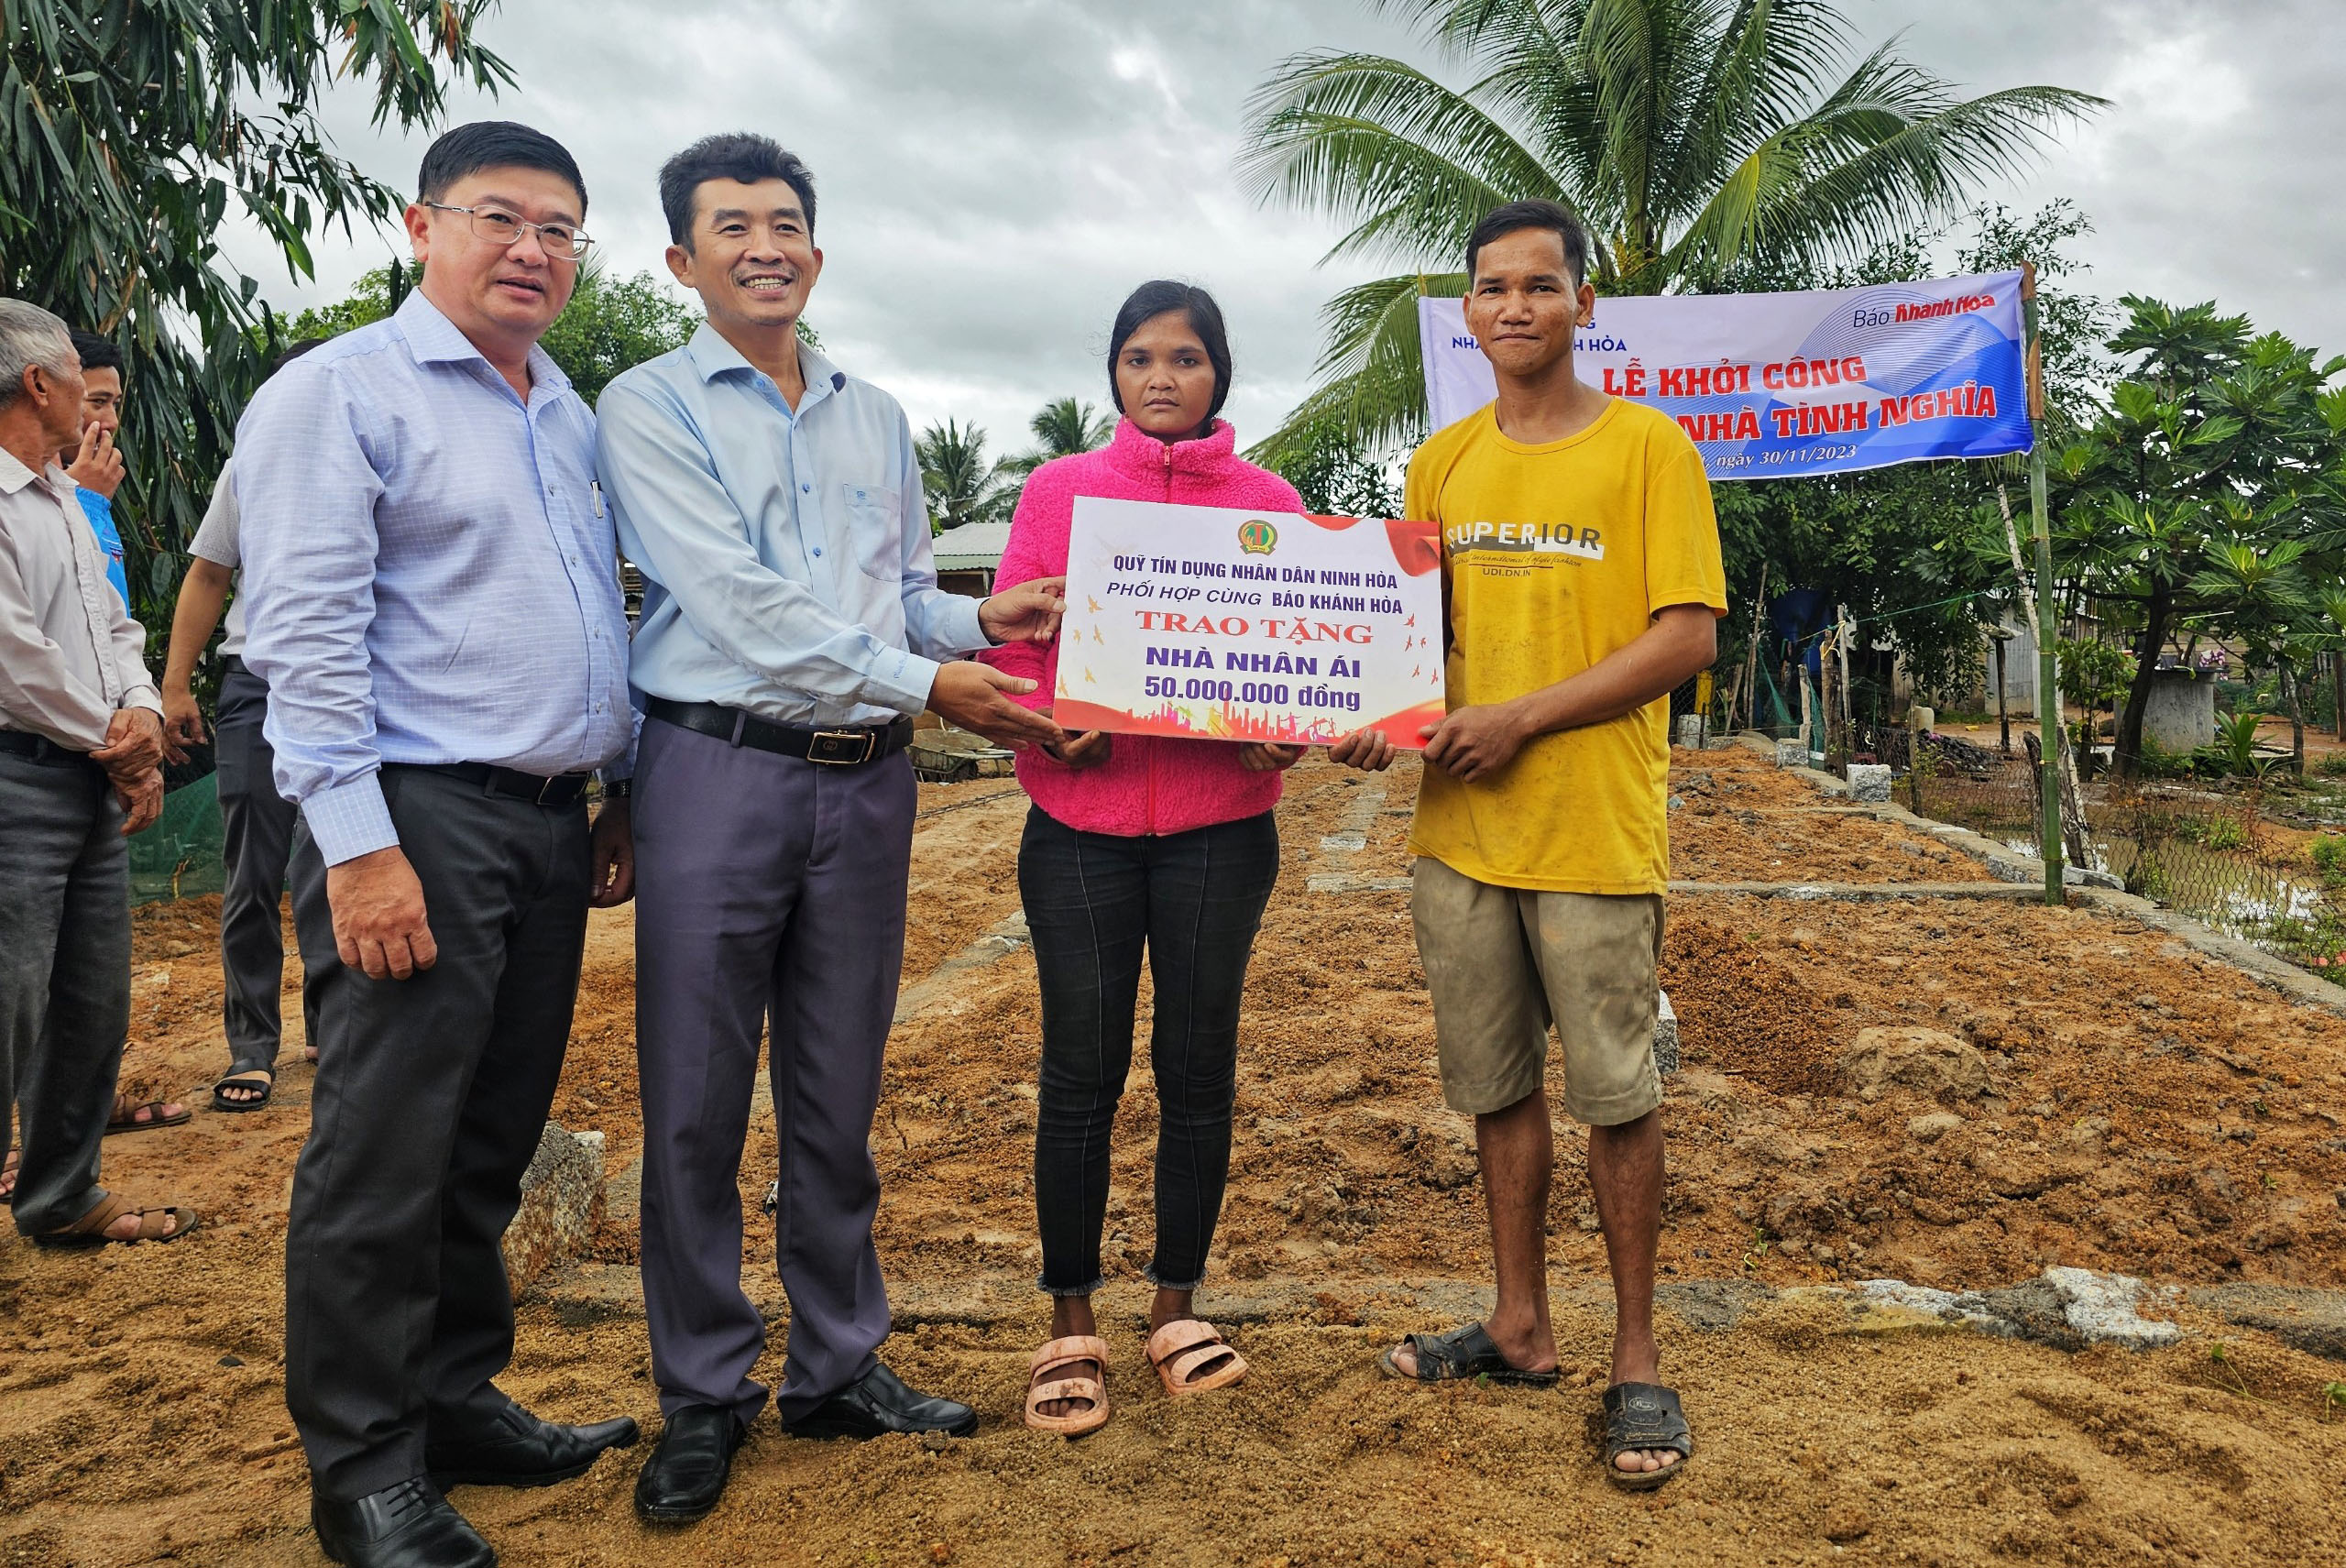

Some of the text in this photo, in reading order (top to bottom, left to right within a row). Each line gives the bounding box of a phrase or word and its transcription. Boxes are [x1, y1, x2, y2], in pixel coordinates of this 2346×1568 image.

[1854, 308, 1890, 328] Báo
[1452, 336, 1480, 350] NH
[1589, 334, 1628, 352] HÒA
[1603, 356, 1868, 397] LỄ KHỞI CÔNG
[1676, 380, 1997, 442] NHÀ TÌNH NGHĨA
[1716, 453, 1754, 470] ngày
[1759, 444, 1858, 466] 30/11/2023
[1446, 522, 1602, 551] SUPERIOR
[1113, 554, 1398, 589] QUỸ TÍN DỤNG NHÂN DÂN NINH HÒA
[1106, 579, 1403, 614] PHỐI HỢP CÙNG BÁO KHÁNH HÒA
[1135, 610, 1375, 646] TRAO TẶNG
[1146, 646, 1361, 678] NHÀ NHÂN ÁI
[1145, 675, 1361, 712] 50.000.000 đồng
